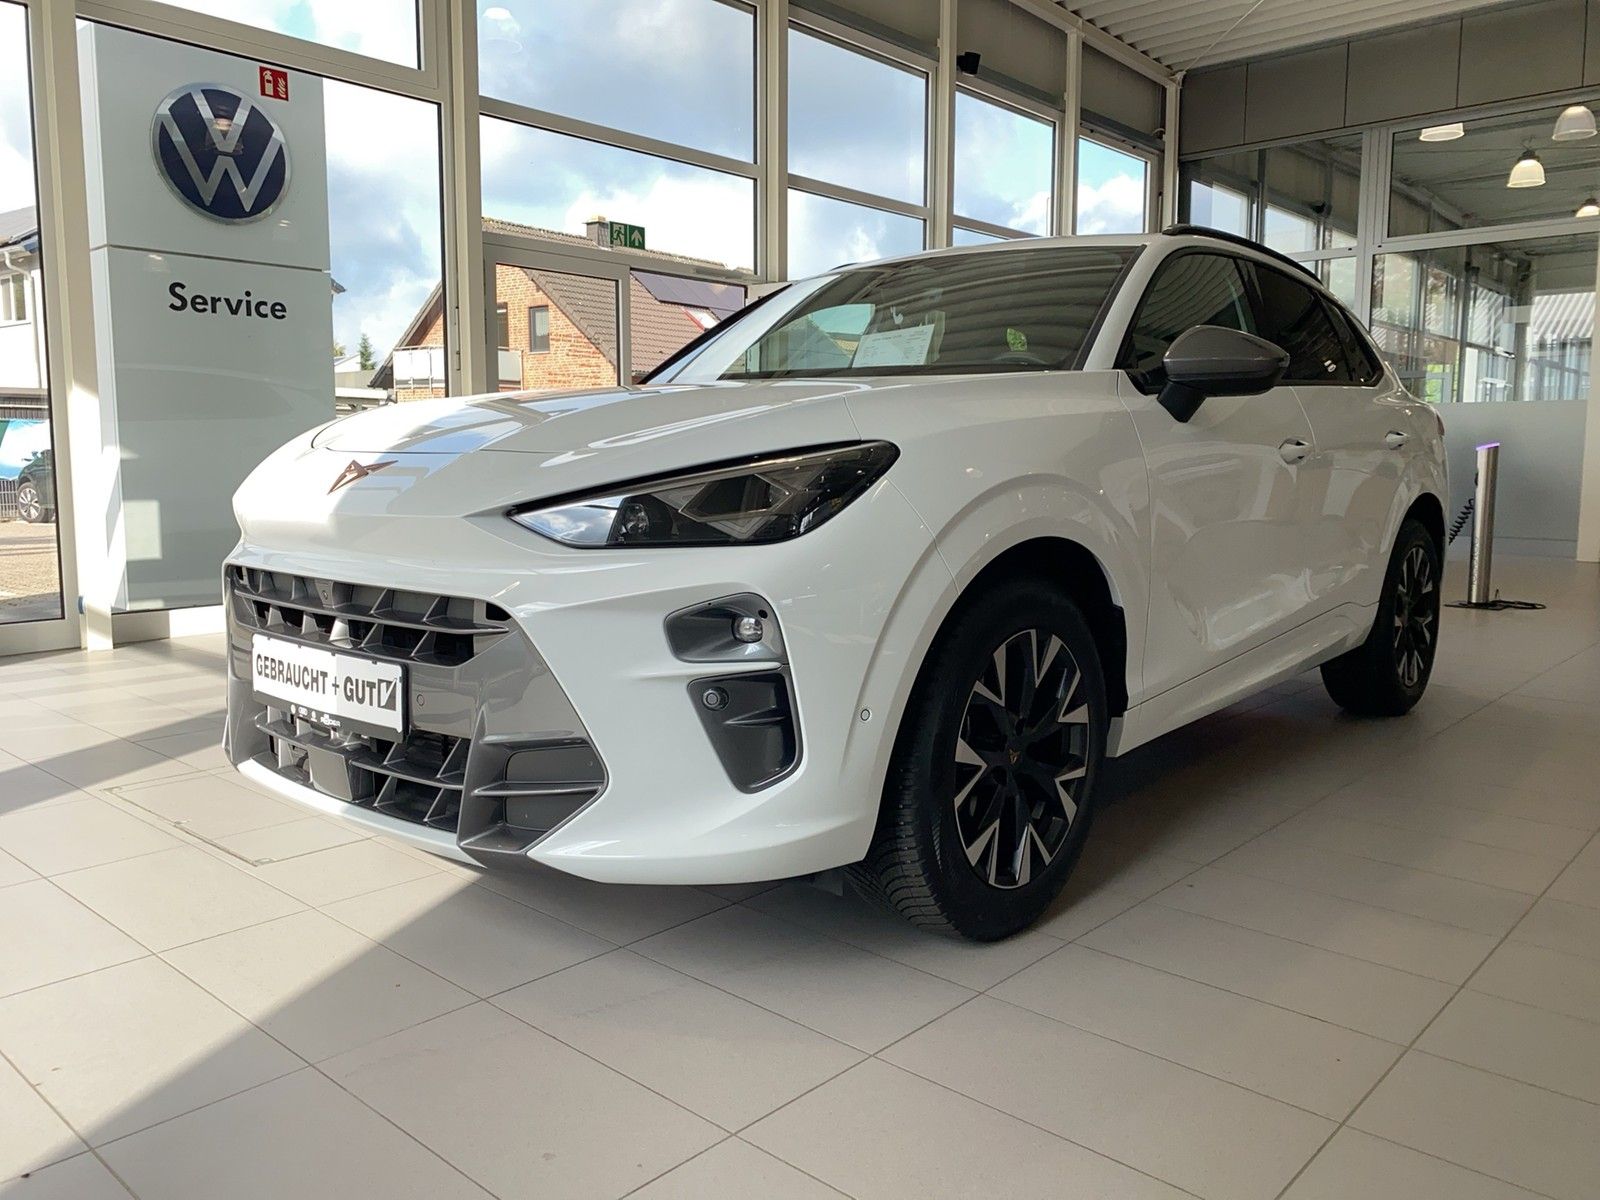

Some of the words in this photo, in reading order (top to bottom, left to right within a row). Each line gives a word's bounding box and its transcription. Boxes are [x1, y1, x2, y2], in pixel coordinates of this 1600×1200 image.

[156, 89, 285, 213] VW
[168, 281, 287, 320] Service
[256, 653, 328, 695] GEBRAUCHT
[343, 675, 377, 707] GUT
